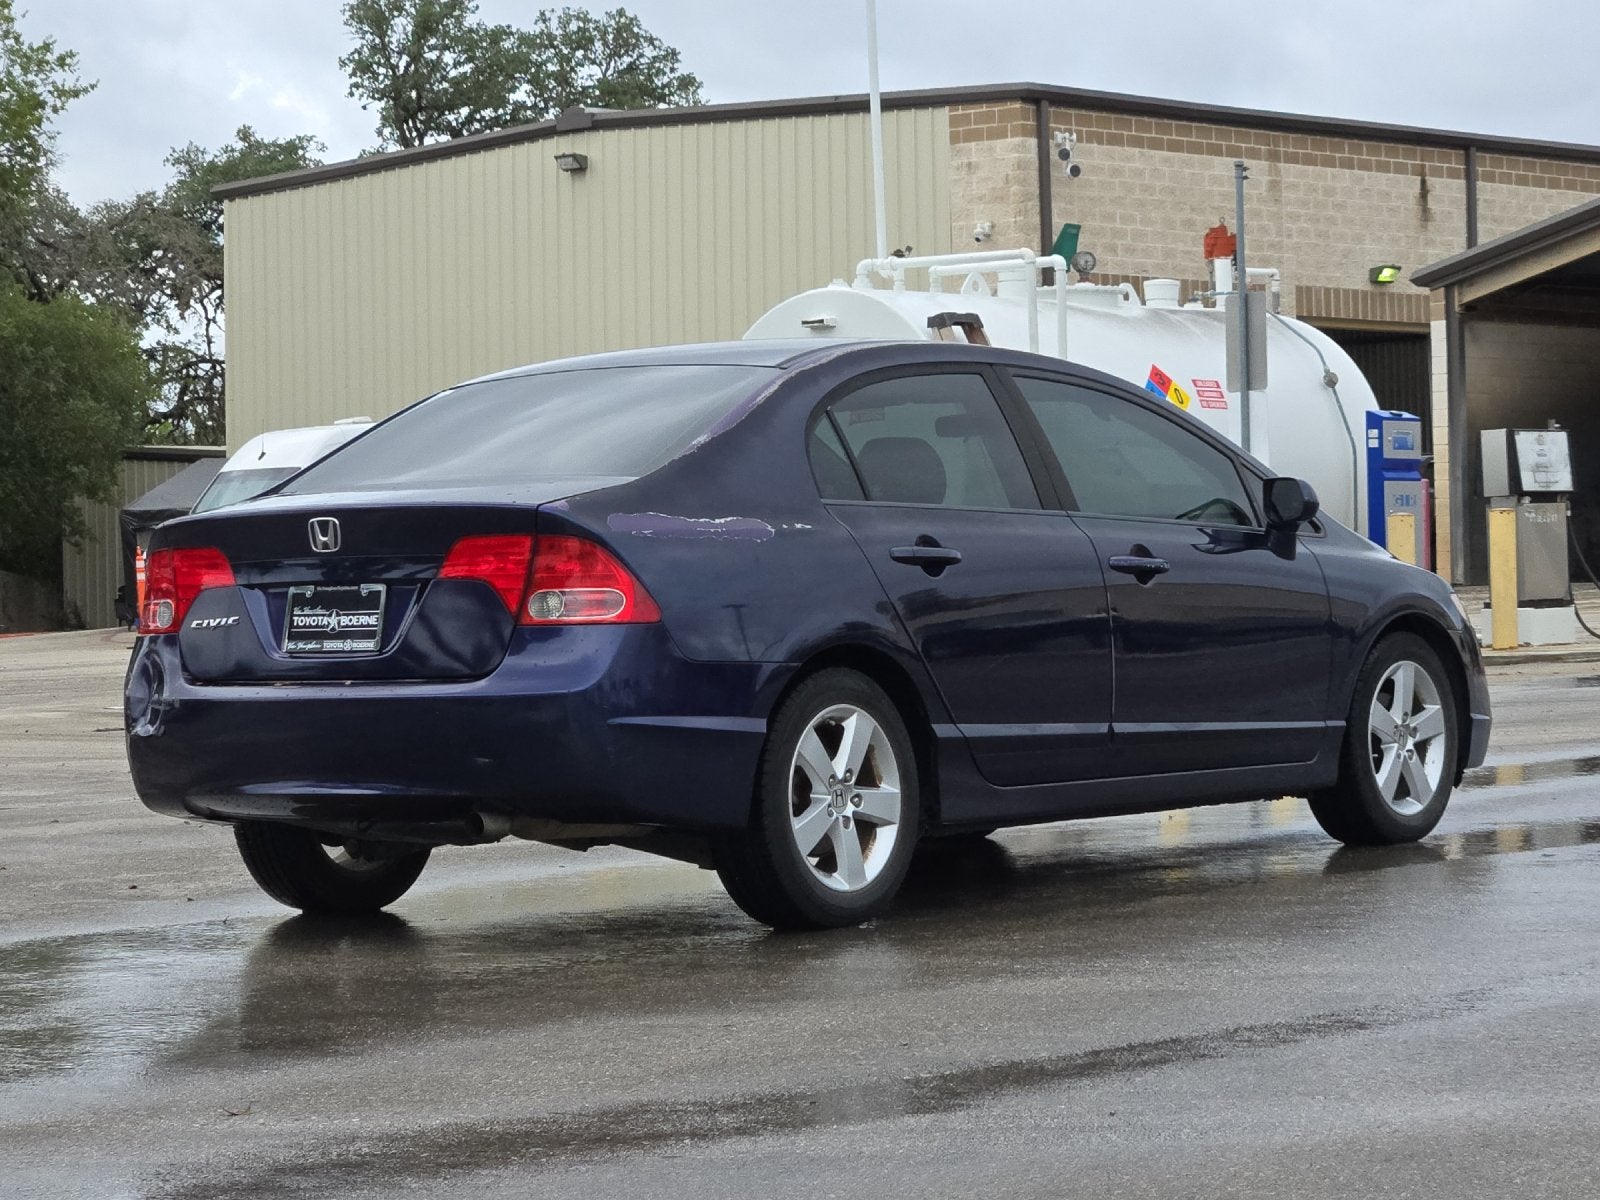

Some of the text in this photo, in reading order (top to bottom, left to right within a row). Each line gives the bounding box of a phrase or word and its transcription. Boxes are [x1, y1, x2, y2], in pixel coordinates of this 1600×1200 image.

[1154, 372, 1167, 386] 3
[1174, 387, 1184, 405] 0
[190, 616, 240, 628] CIVIC
[292, 615, 379, 626] TOYOTA BOERNE
